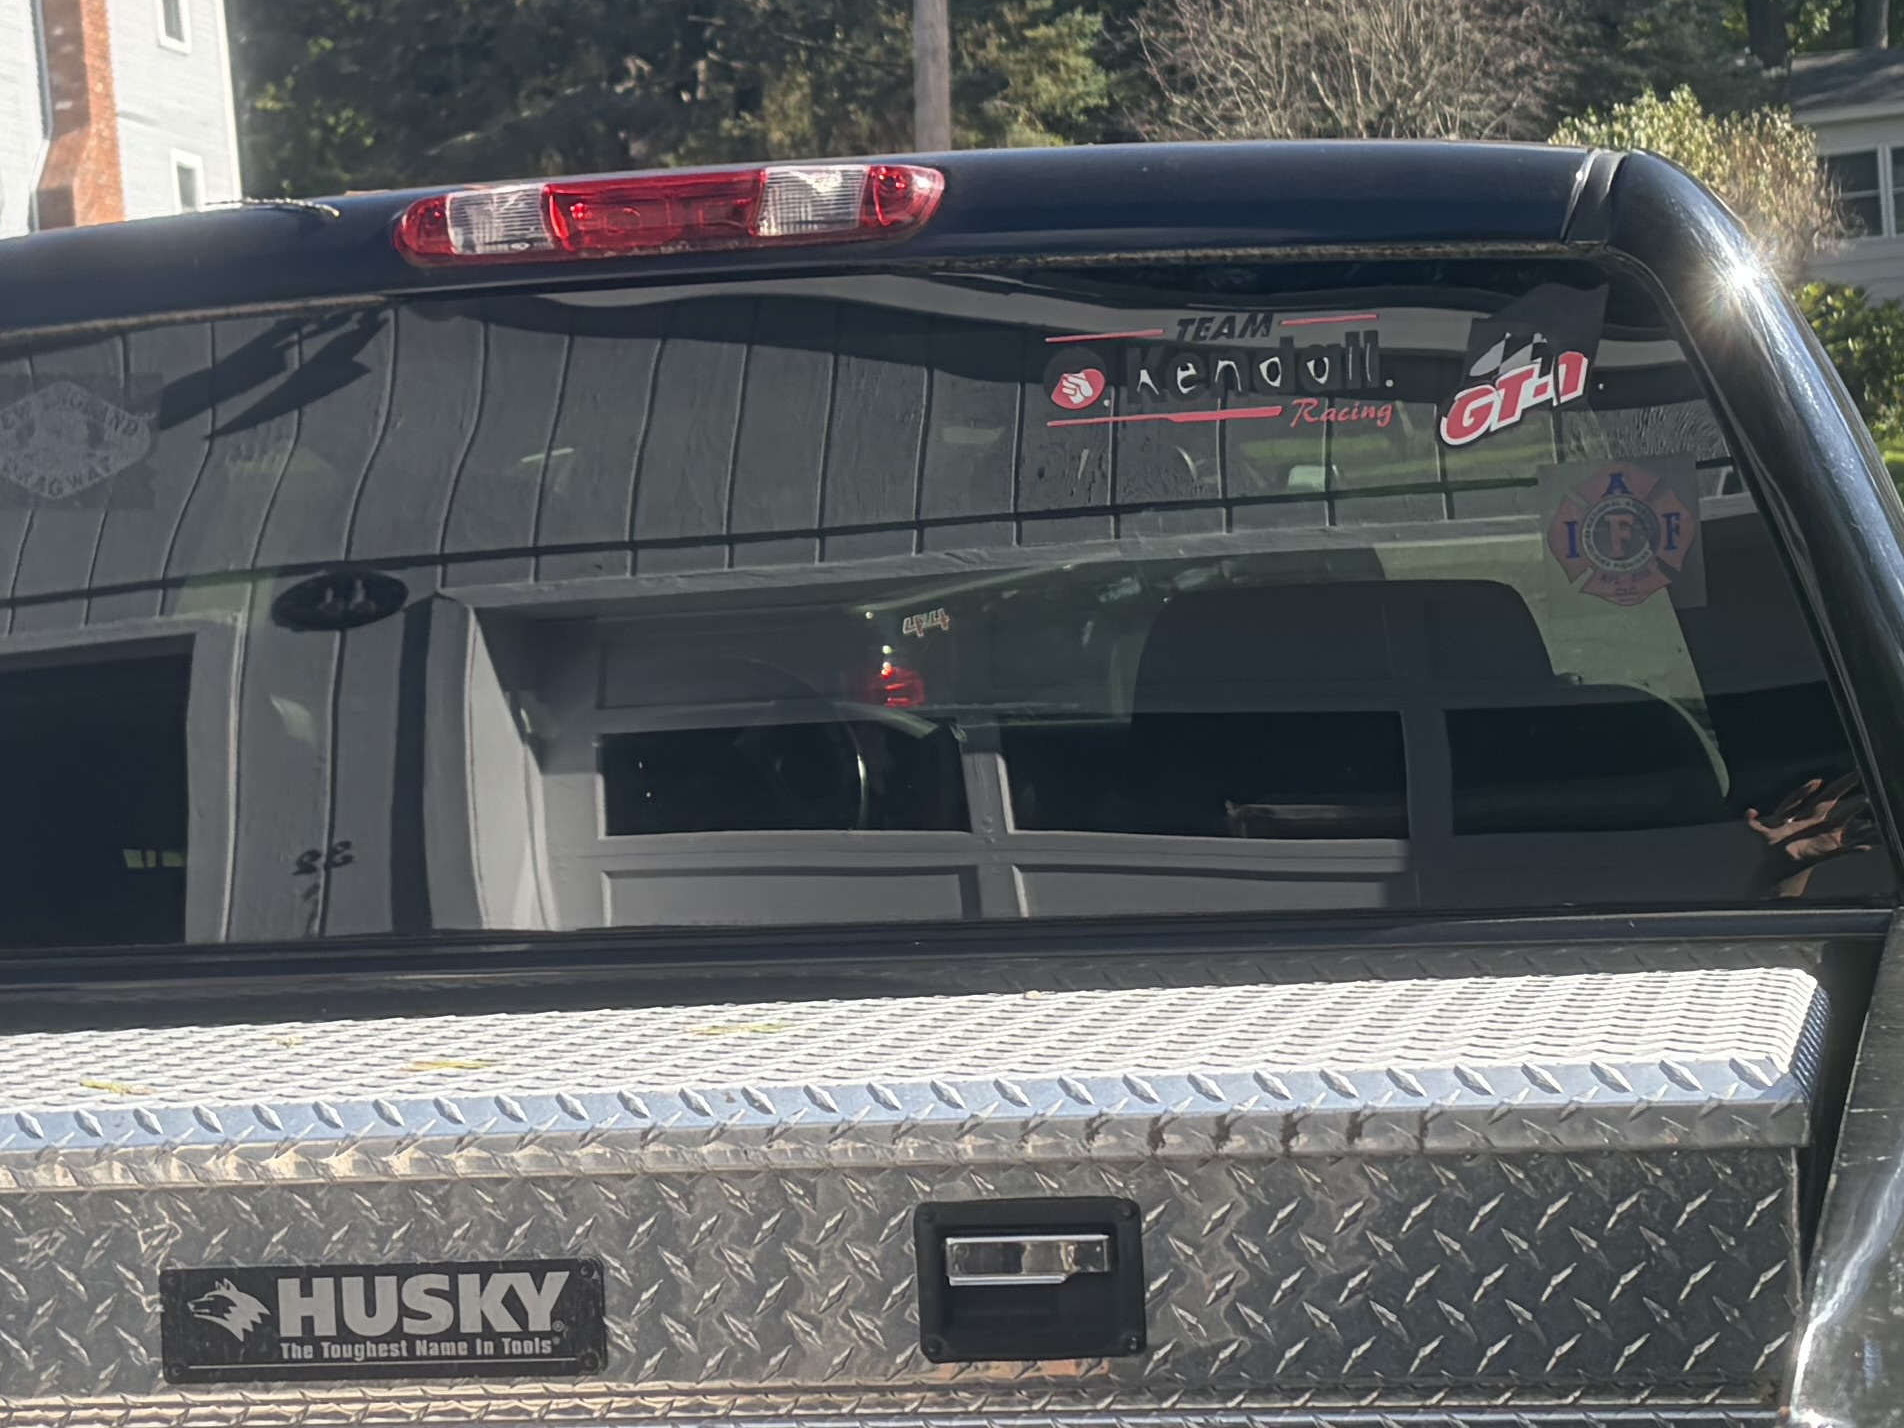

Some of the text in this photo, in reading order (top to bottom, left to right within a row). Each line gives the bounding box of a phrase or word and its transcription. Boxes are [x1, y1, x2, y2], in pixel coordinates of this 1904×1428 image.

[1176, 312, 1274, 342] TEAM
[1125, 329, 1381, 405] Kendall
[1290, 397, 1394, 428] Racing
[1440, 350, 1589, 446] GT-1
[1602, 472, 1634, 497] A
[277, 1271, 570, 1337] HUSKY
[280, 1335, 552, 1362] The Toughest Name In Tools
